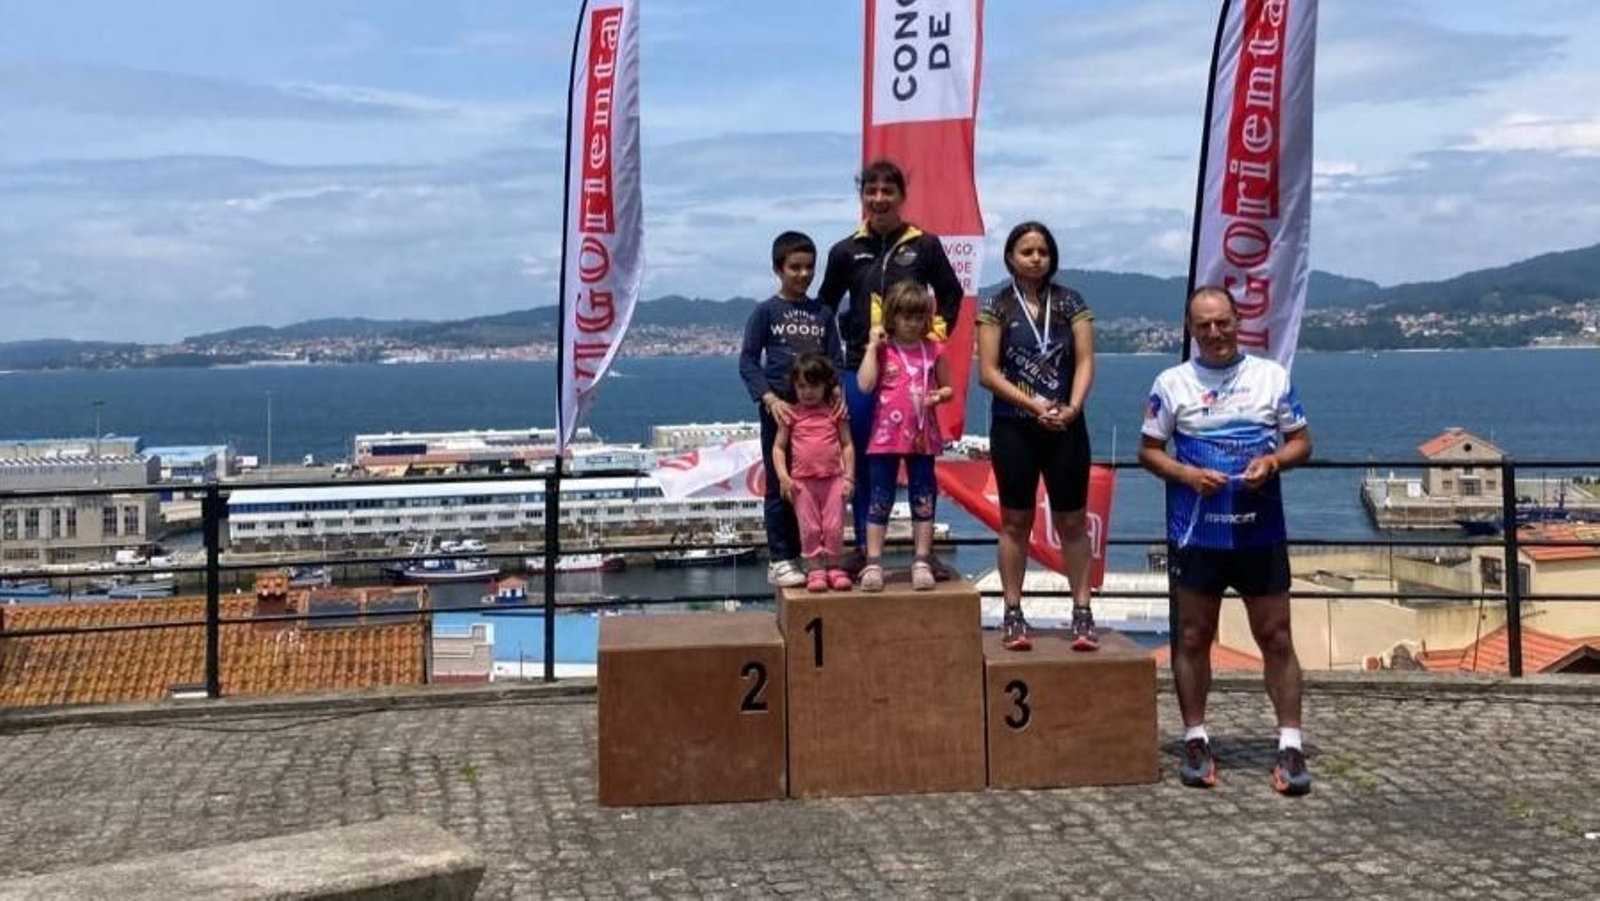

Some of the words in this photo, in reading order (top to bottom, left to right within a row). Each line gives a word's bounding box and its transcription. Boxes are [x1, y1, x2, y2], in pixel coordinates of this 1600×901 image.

[893, 0, 918, 101] CON
[928, 12, 951, 70] DE
[805, 618, 823, 668] 1
[740, 662, 768, 711] 2
[1004, 680, 1031, 729] 3
